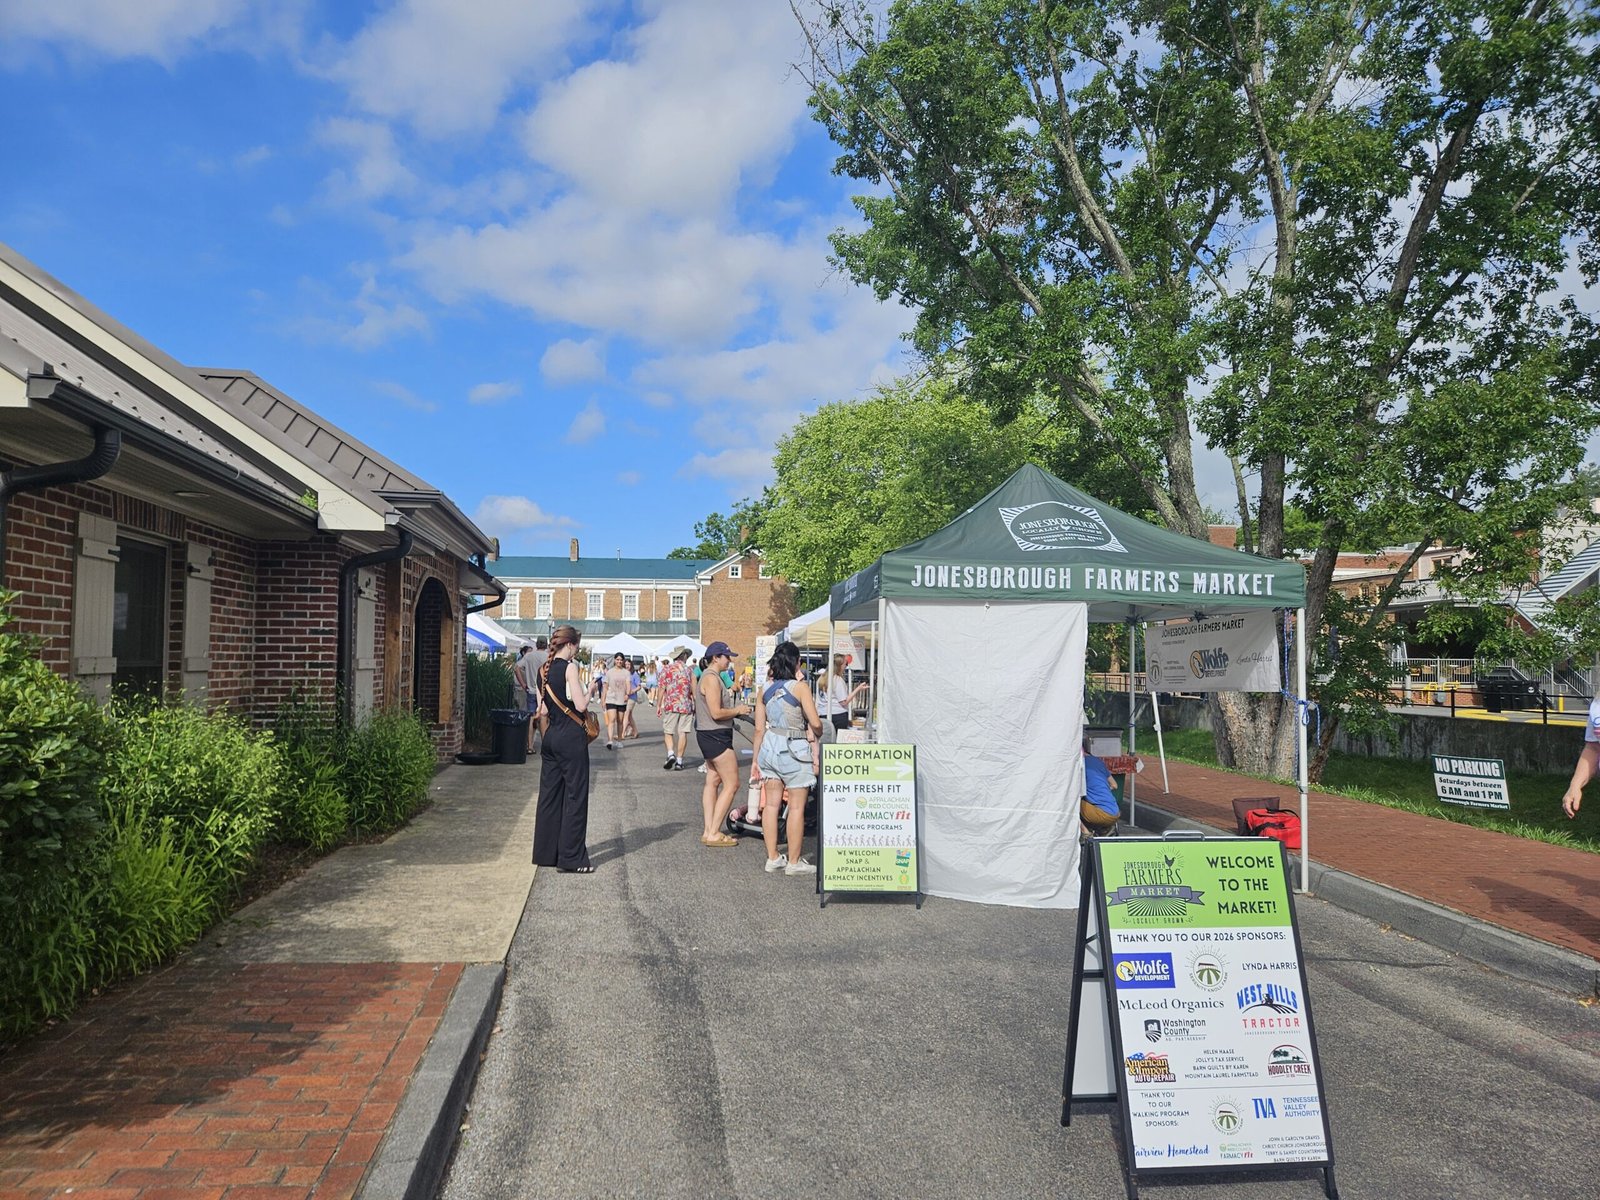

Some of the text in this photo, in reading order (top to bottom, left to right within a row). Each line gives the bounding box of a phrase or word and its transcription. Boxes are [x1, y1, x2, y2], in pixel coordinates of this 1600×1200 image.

[1019, 517, 1100, 531] JONESBOROUGH
[910, 564, 1072, 590] JONESBOROUGH
[1084, 566, 1180, 593] FARMERS
[1192, 571, 1275, 597] MARKET
[1161, 618, 1245, 639] JONESBOROUGH FARMERS MARKET
[1200, 647, 1230, 670] Wolfe
[824, 749, 912, 760] INFORMATION
[824, 765, 870, 775] BOOTH
[1434, 757, 1501, 777] NO PARKING
[823, 784, 902, 793] FARM FRESH FIT
[1438, 776, 1502, 789] Saturdays between
[1441, 785, 1503, 801] 6 AM and 1 PM
[855, 810, 911, 820] FARMACY fit
[1123, 861, 1166, 870] JONESBOROUGH
[1205, 856, 1275, 869] WELCOME
[1124, 868, 1183, 886] FARMERS
[1218, 878, 1269, 891] TO THE
[1130, 887, 1180, 896] MARKET
[1217, 900, 1277, 914] MARKET!
[1132, 917, 1159, 925] LOCALLY
[1117, 931, 1287, 943] THANK YOU TO OUR 2026 SPONSORS:
[1130, 959, 1170, 975] Wolfe
[1242, 961, 1298, 971] LYNDA HARRIS
[1236, 983, 1298, 1010] WEST HILLS
[1119, 997, 1225, 1013] McLeod Organics
[1162, 1019, 1207, 1028] Washington
[1242, 1017, 1300, 1029] TRACTOR
[1163, 1027, 1190, 1036] County
[1125, 1057, 1169, 1068] American
[1293, 1064, 1312, 1075] CREEK
[1135, 1073, 1176, 1083] AUTO REPAIR
[1282, 1096, 1319, 1104] TENNESSEE
[1251, 1097, 1277, 1119] TVA
[1134, 1143, 1209, 1158] airview Homestead
